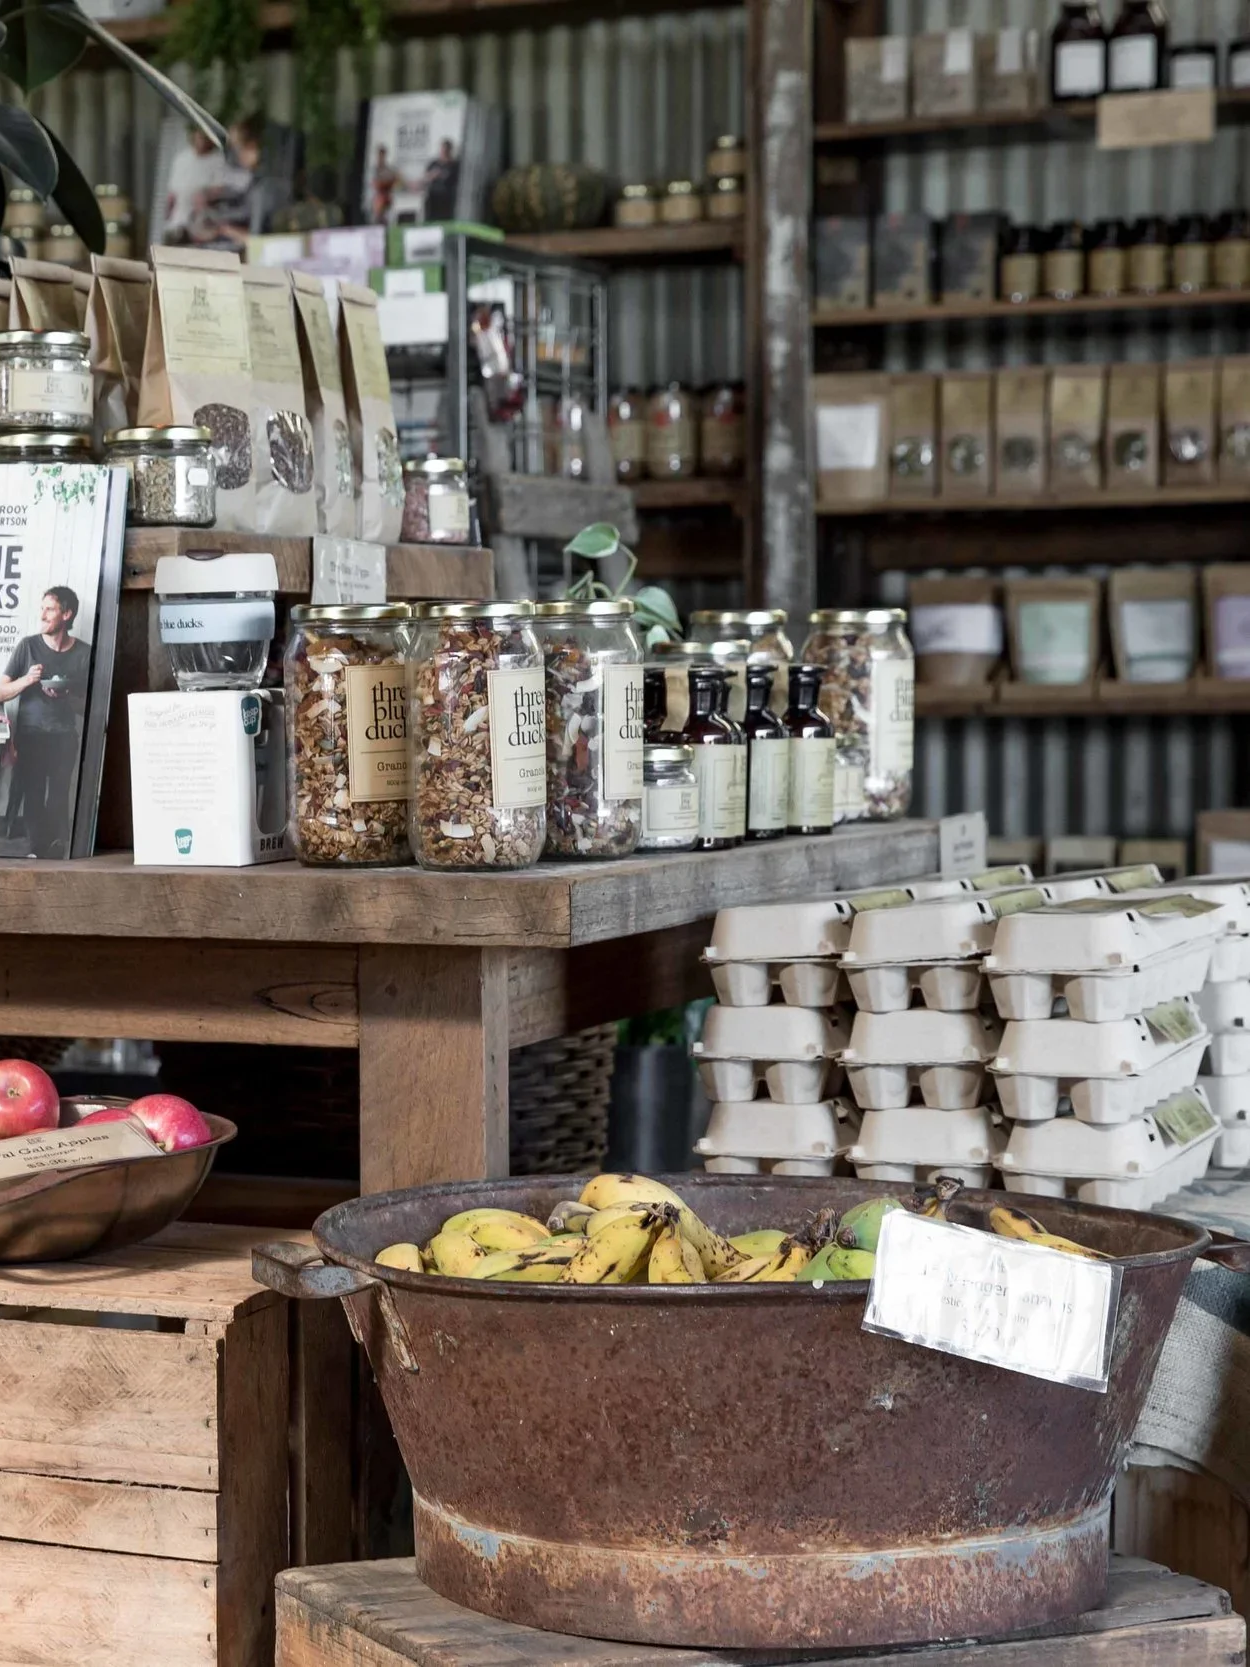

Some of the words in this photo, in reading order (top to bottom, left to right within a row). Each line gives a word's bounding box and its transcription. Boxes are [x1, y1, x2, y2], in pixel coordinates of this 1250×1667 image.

[177, 618, 205, 629] ducks.
[372, 681, 406, 701] thre
[243, 707, 259, 720] keep
[373, 698, 406, 722] blu
[243, 716, 256, 728] cup
[365, 718, 407, 741] duc
[508, 722, 546, 747] duck
[259, 834, 284, 851] BREW
[18, 1144, 53, 1155] Gala
[57, 1134, 110, 1150] Apples
